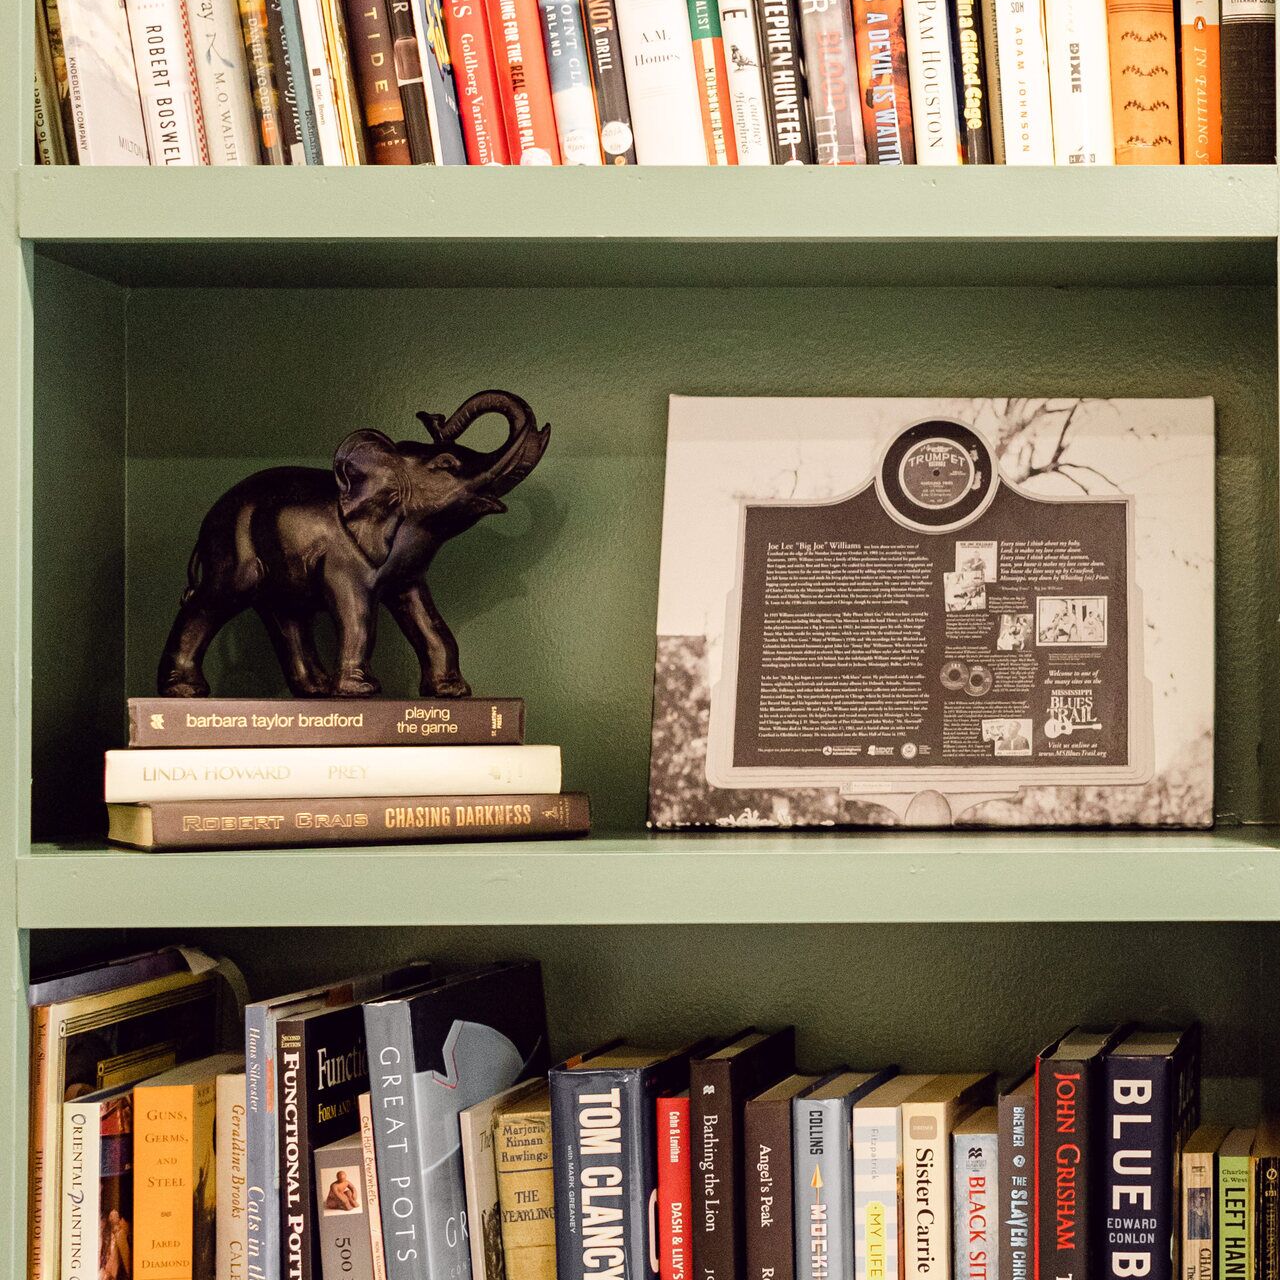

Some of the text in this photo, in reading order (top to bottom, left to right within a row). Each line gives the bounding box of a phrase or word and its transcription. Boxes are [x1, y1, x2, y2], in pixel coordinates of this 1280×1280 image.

[918, 0, 944, 149] PAM HOUSTON
[908, 452, 966, 467] TRUMPET
[768, 542, 780, 551] Joe
[781, 542, 794, 550] Lee
[829, 541, 861, 550] Williams
[1048, 670, 1072, 678] Welcome
[1050, 697, 1093, 709] BLUES
[186, 712, 364, 730] barbara taylor bradford
[405, 707, 451, 722] playing
[1046, 708, 1097, 723] TRAIL
[396, 721, 459, 736] the game
[182, 812, 369, 832] ROBERT CRAIS
[385, 805, 532, 828] CHASING DARKNESS
[147, 1108, 188, 1122] GUNS,
[1112, 1079, 1152, 1211] BLUE
[157, 1156, 178, 1165] AND
[378, 1047, 418, 1263] GREAT POTS
[148, 1176, 186, 1188] STEEL
[915, 1147, 935, 1274] Sister Carrie
[1107, 1217, 1157, 1231] EDWARD
[1108, 1231, 1155, 1244] CONLON
